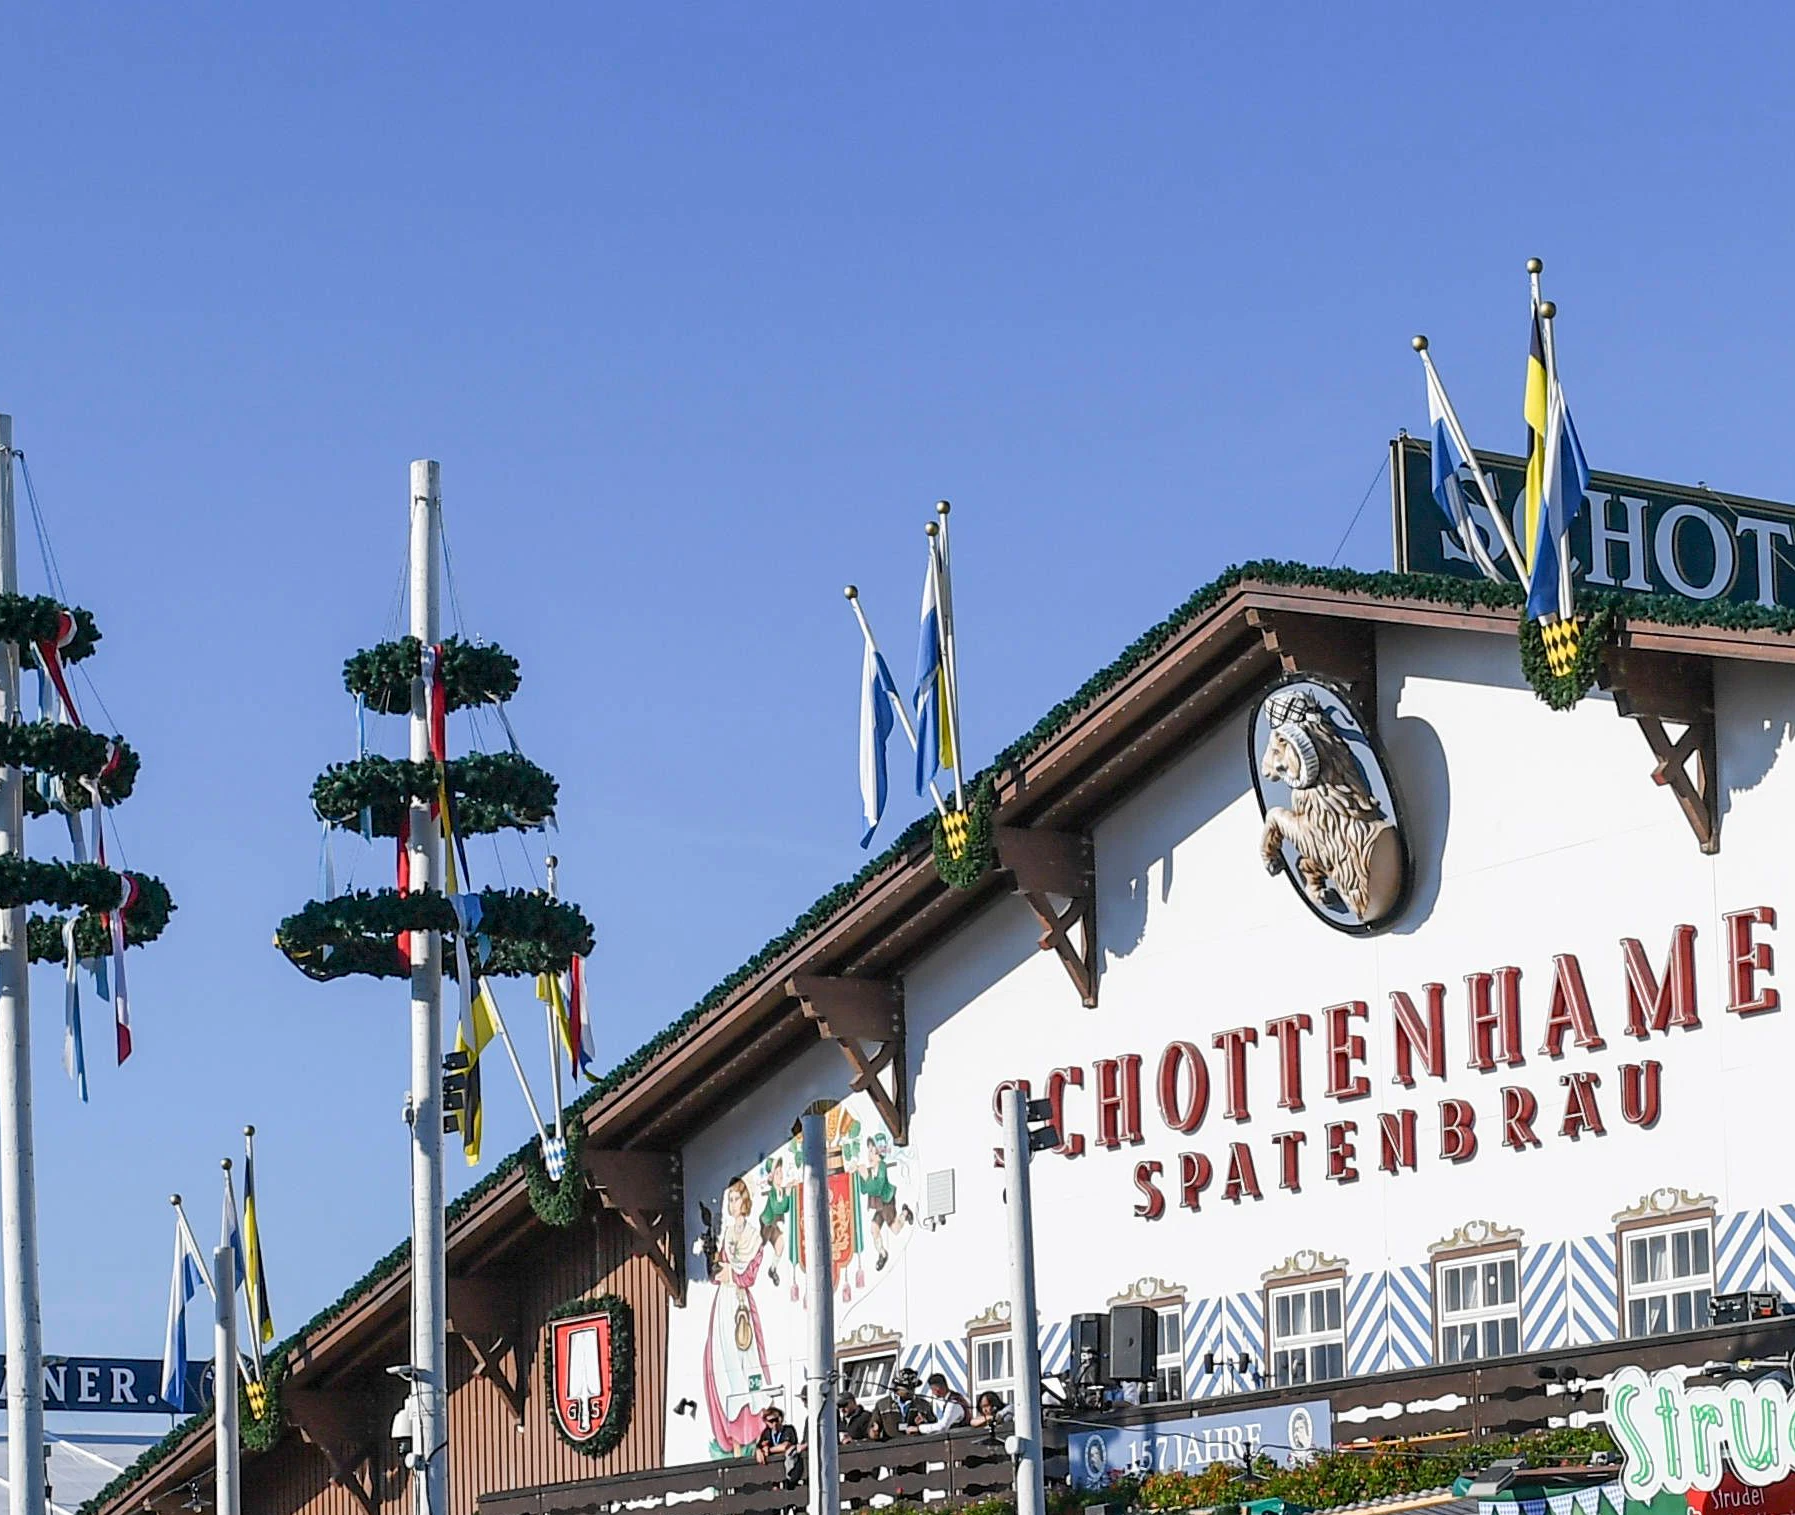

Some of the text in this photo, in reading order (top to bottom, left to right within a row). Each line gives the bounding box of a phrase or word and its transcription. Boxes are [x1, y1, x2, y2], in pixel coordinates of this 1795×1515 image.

[1134, 1059, 1663, 1221] SPATENBRÄU
[1128, 1422, 1263, 1471] 157 JAHRE
[1711, 1486, 1766, 1509] Strudel
